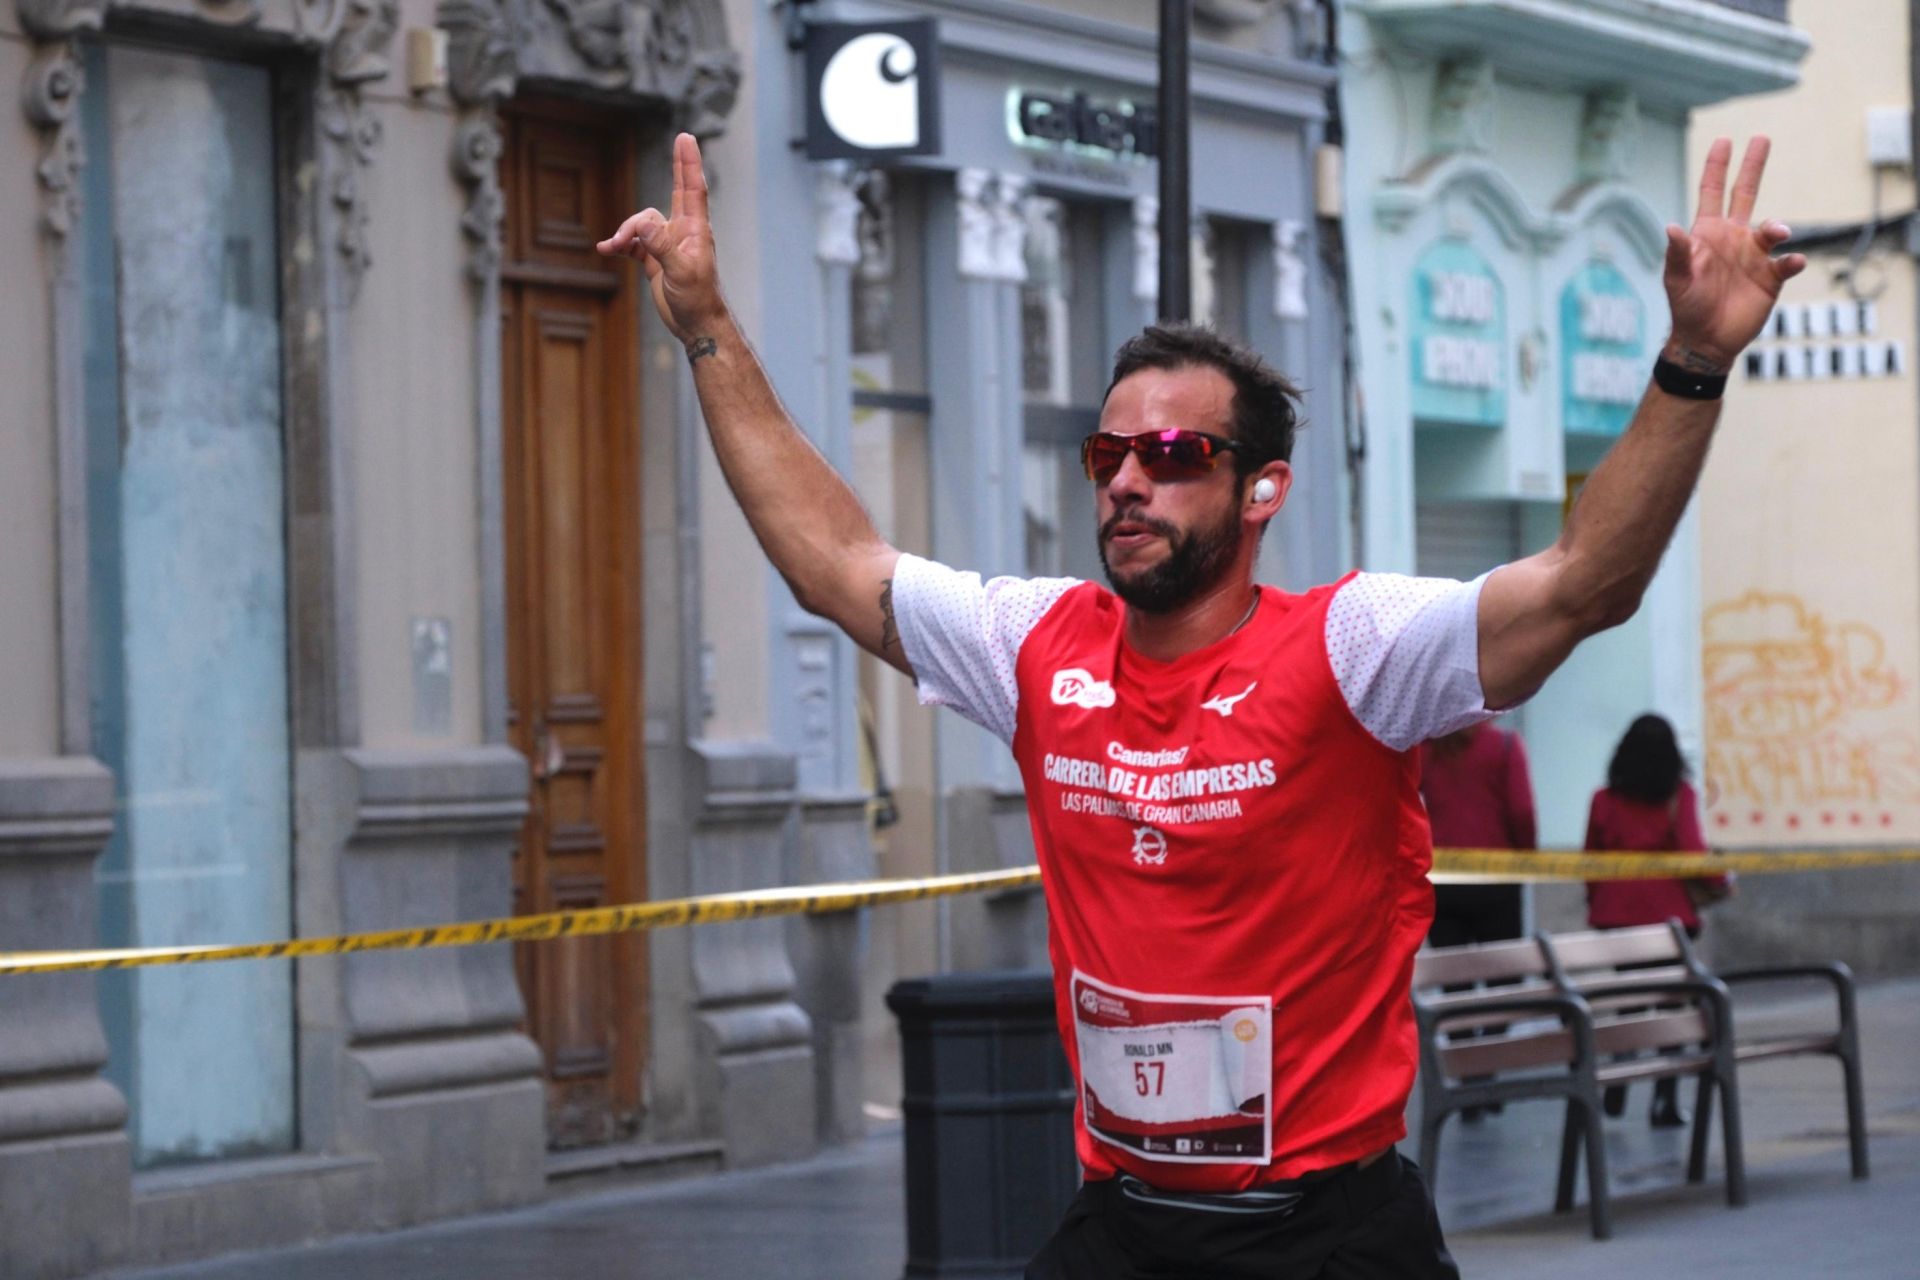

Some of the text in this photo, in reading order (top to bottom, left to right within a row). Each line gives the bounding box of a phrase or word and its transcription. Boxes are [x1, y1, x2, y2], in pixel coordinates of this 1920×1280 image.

[1107, 741, 1189, 768] Canarias7
[1044, 753, 1277, 801] CARRERA DE LAS EMPRESAS
[1061, 792, 1243, 824] LAS PALMAS DE GRAN CANARIA
[1123, 1043, 1155, 1057] RONALD
[1134, 1061, 1165, 1097] 57
